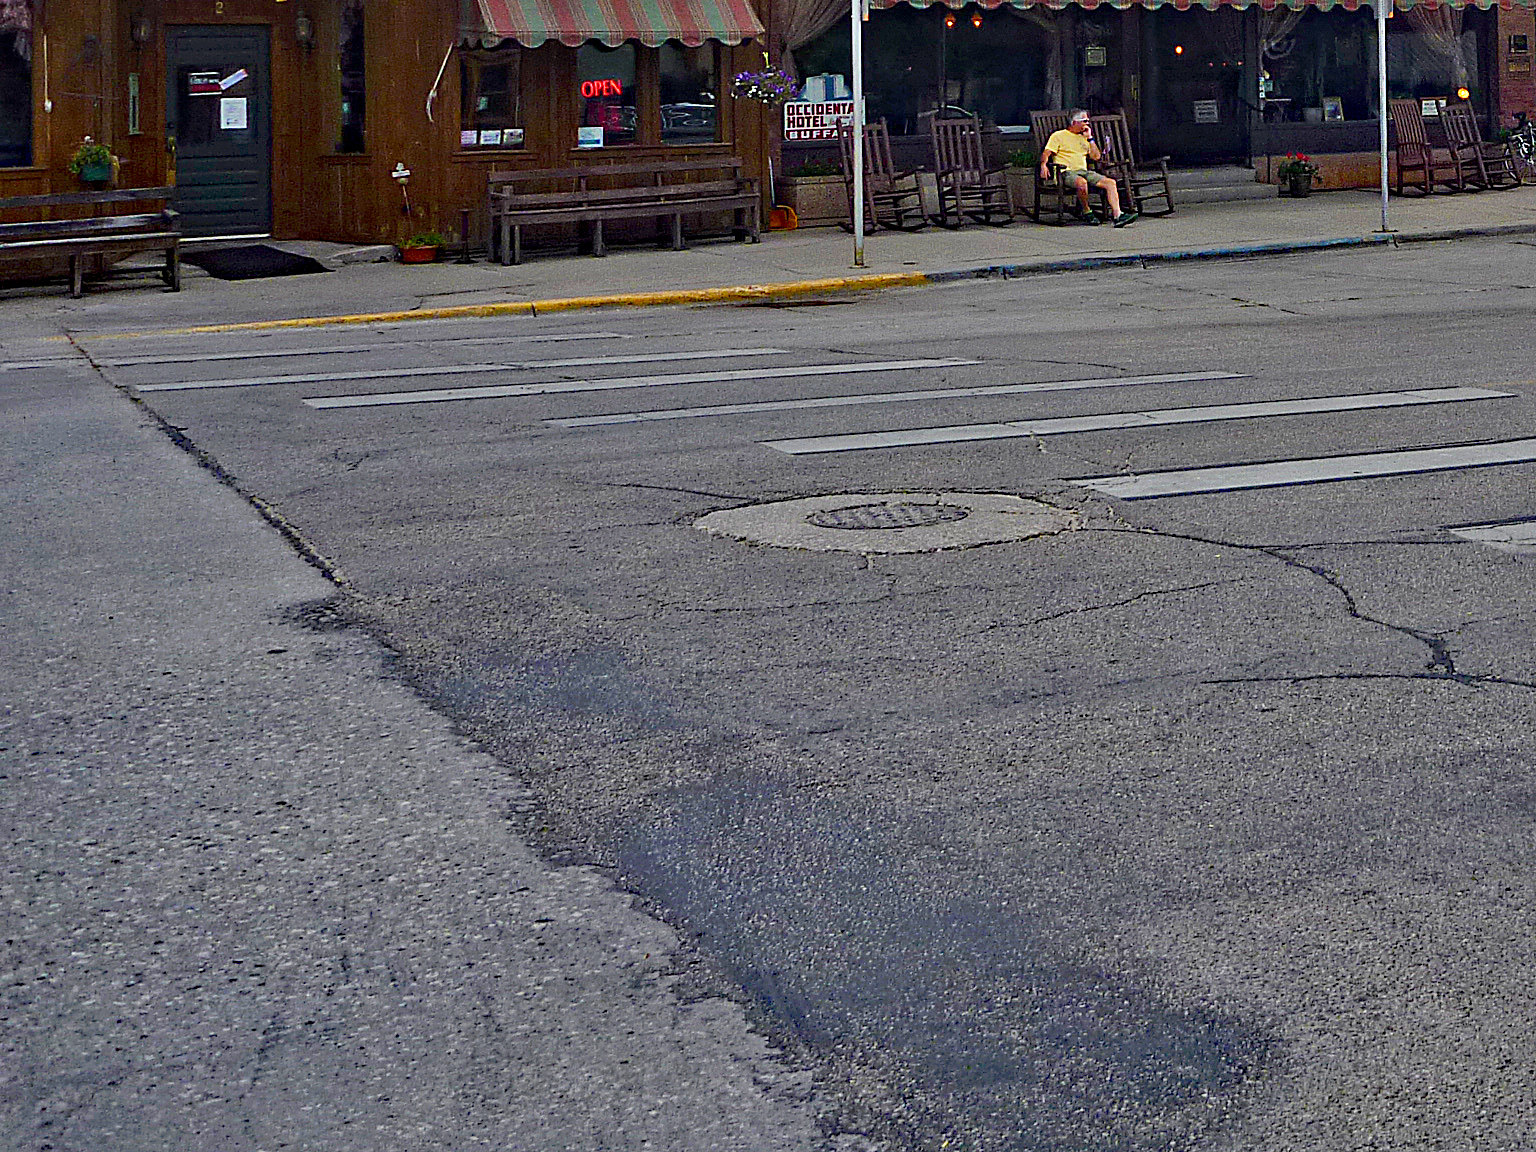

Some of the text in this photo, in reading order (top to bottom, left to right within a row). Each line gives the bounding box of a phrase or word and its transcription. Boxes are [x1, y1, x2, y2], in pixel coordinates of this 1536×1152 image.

[215, 1, 224, 14] 2
[581, 79, 623, 98] OPEN
[787, 103, 854, 115] OCCIDENTA
[787, 116, 827, 128] HOTEL
